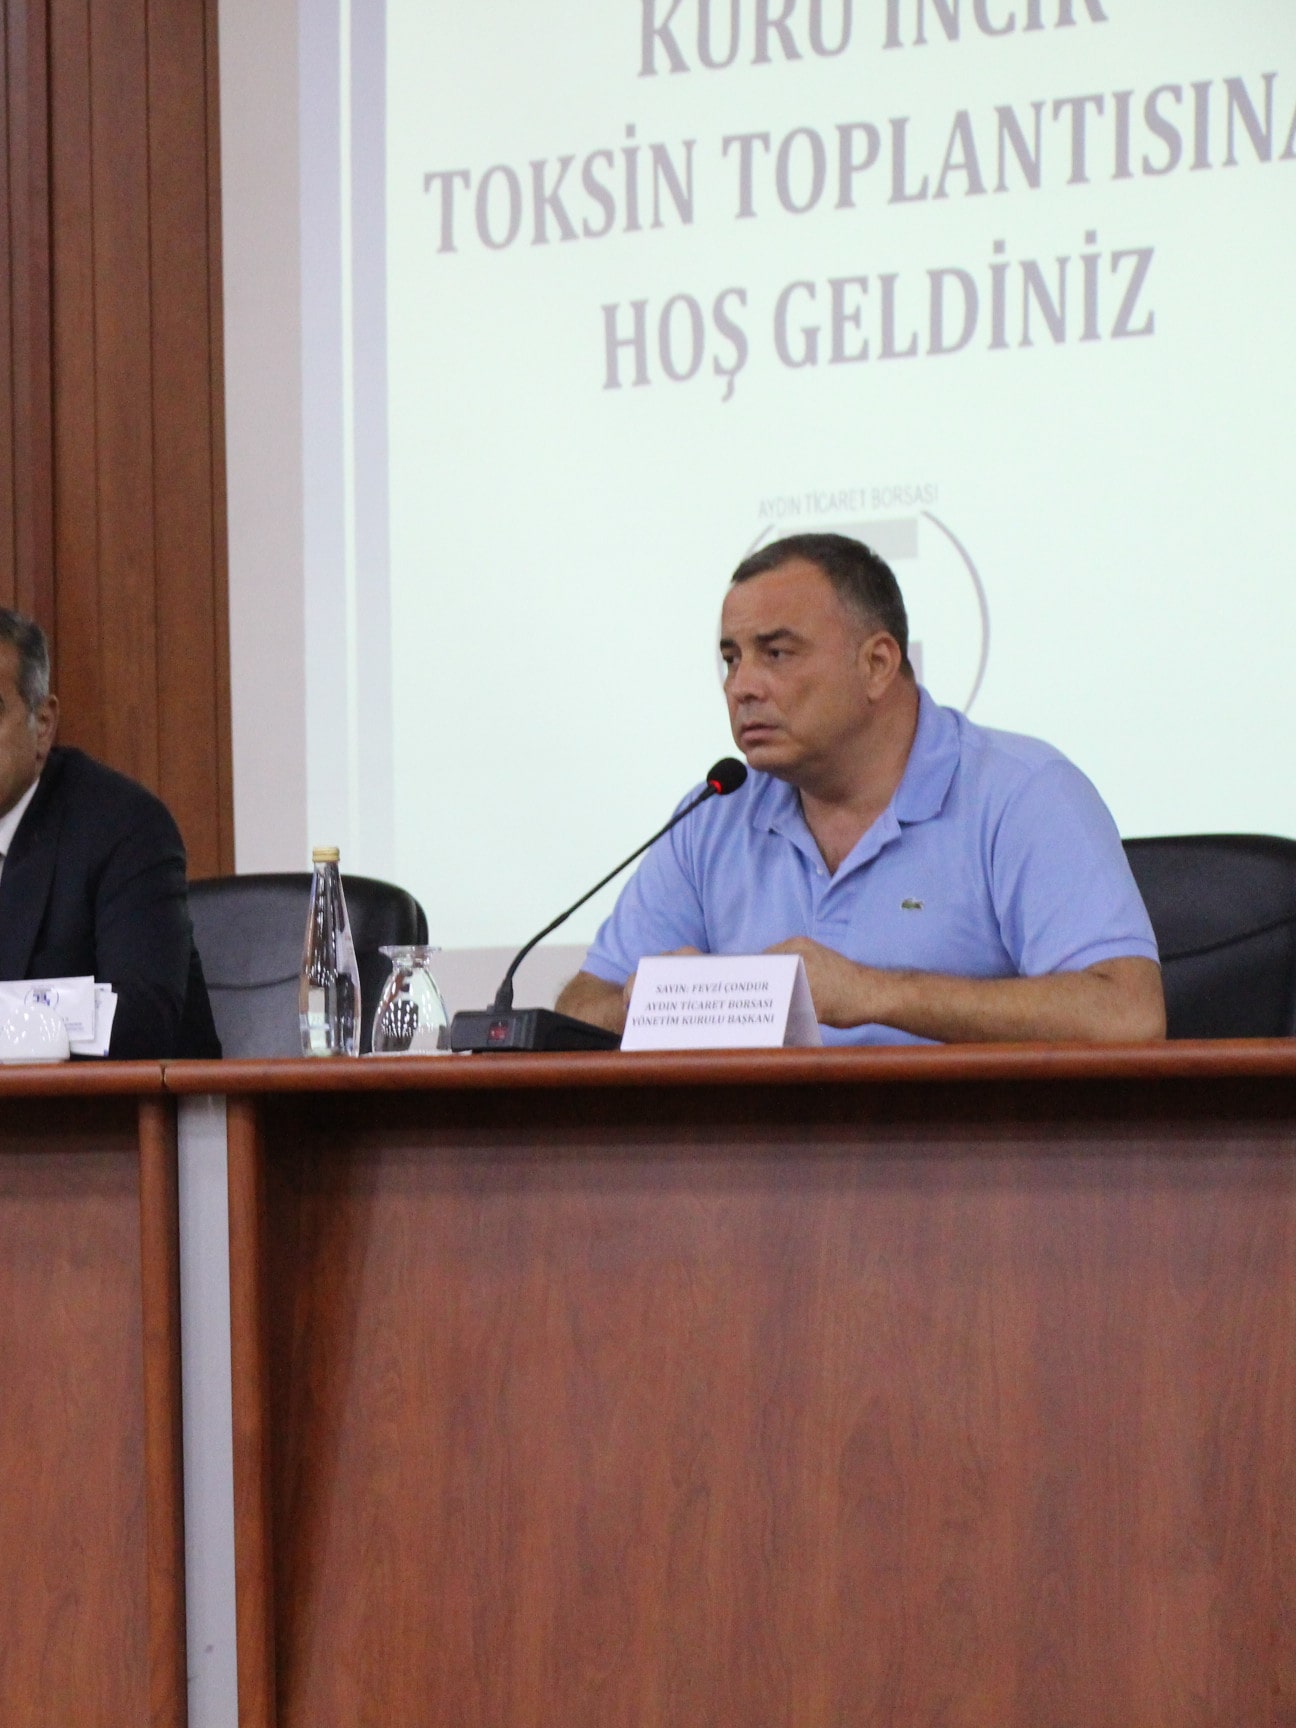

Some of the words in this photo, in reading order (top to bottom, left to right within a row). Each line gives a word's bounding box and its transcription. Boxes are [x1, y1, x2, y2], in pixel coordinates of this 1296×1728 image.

[636, 0, 853, 77] KURU
[423, 123, 697, 254] TOKSİN
[600, 286, 750, 403] HOŞ
[772, 229, 1157, 370] GELDİNİZ
[758, 496, 801, 519] AYDIN
